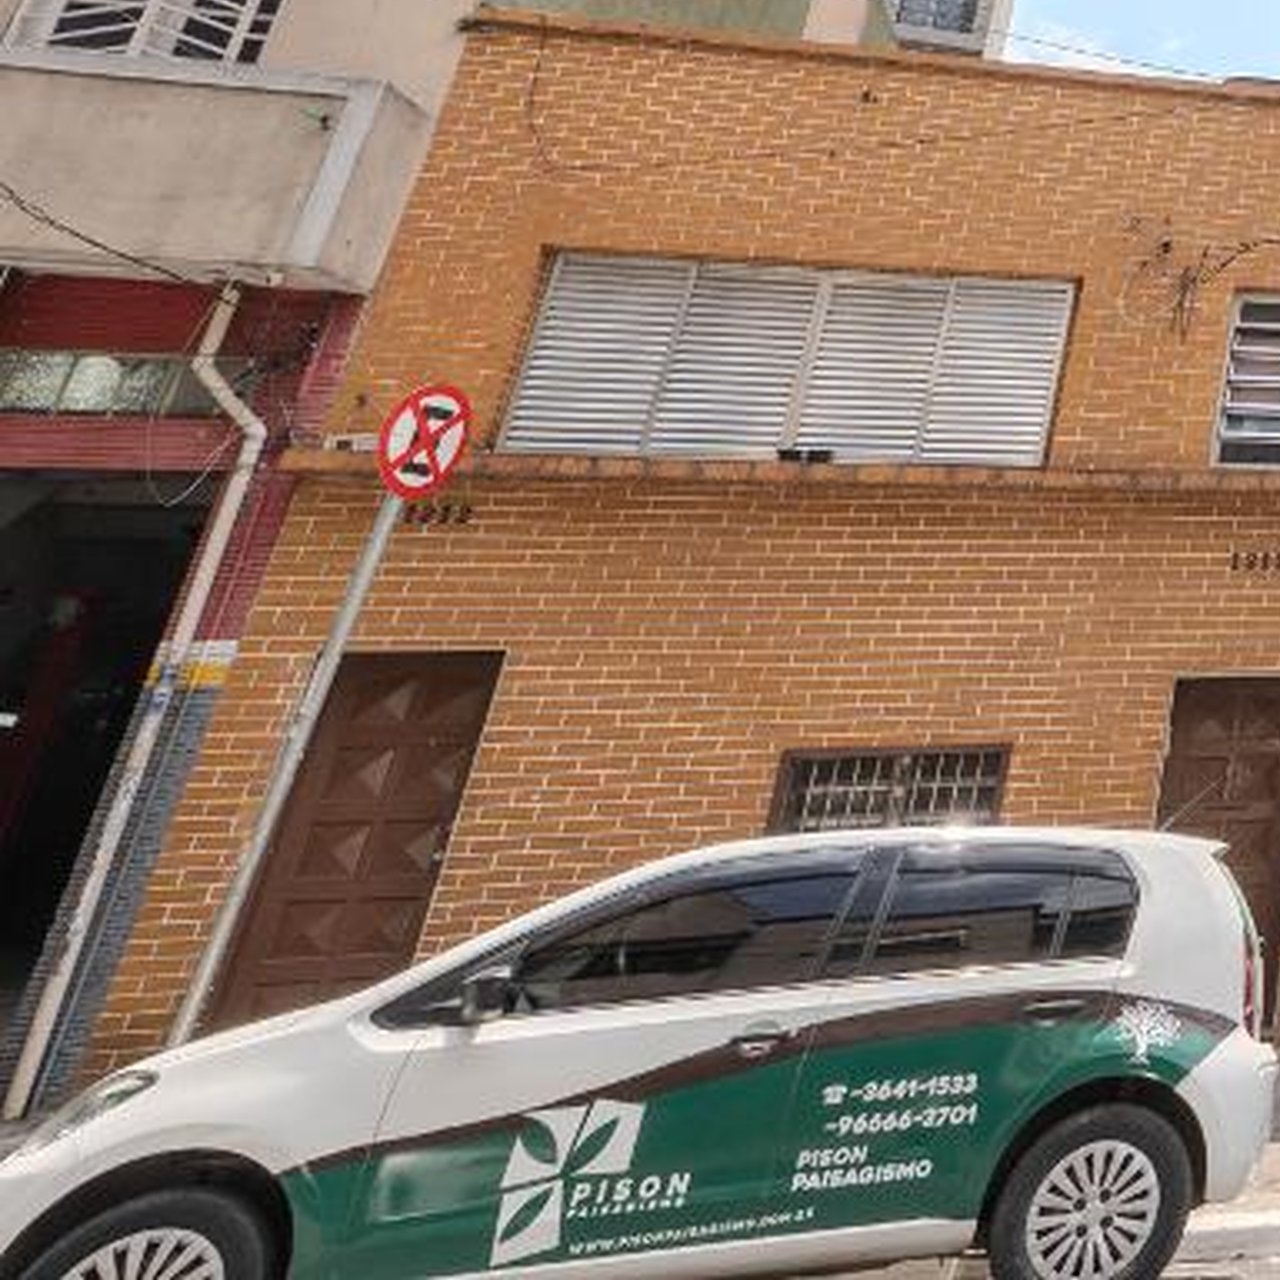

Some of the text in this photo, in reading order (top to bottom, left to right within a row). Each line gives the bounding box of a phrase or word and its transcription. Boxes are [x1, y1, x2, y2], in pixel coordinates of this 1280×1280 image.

[796, 1144, 868, 1170] PISON
[569, 1172, 691, 1208] PISON
[790, 1159, 934, 1192] PAISAGISMO
